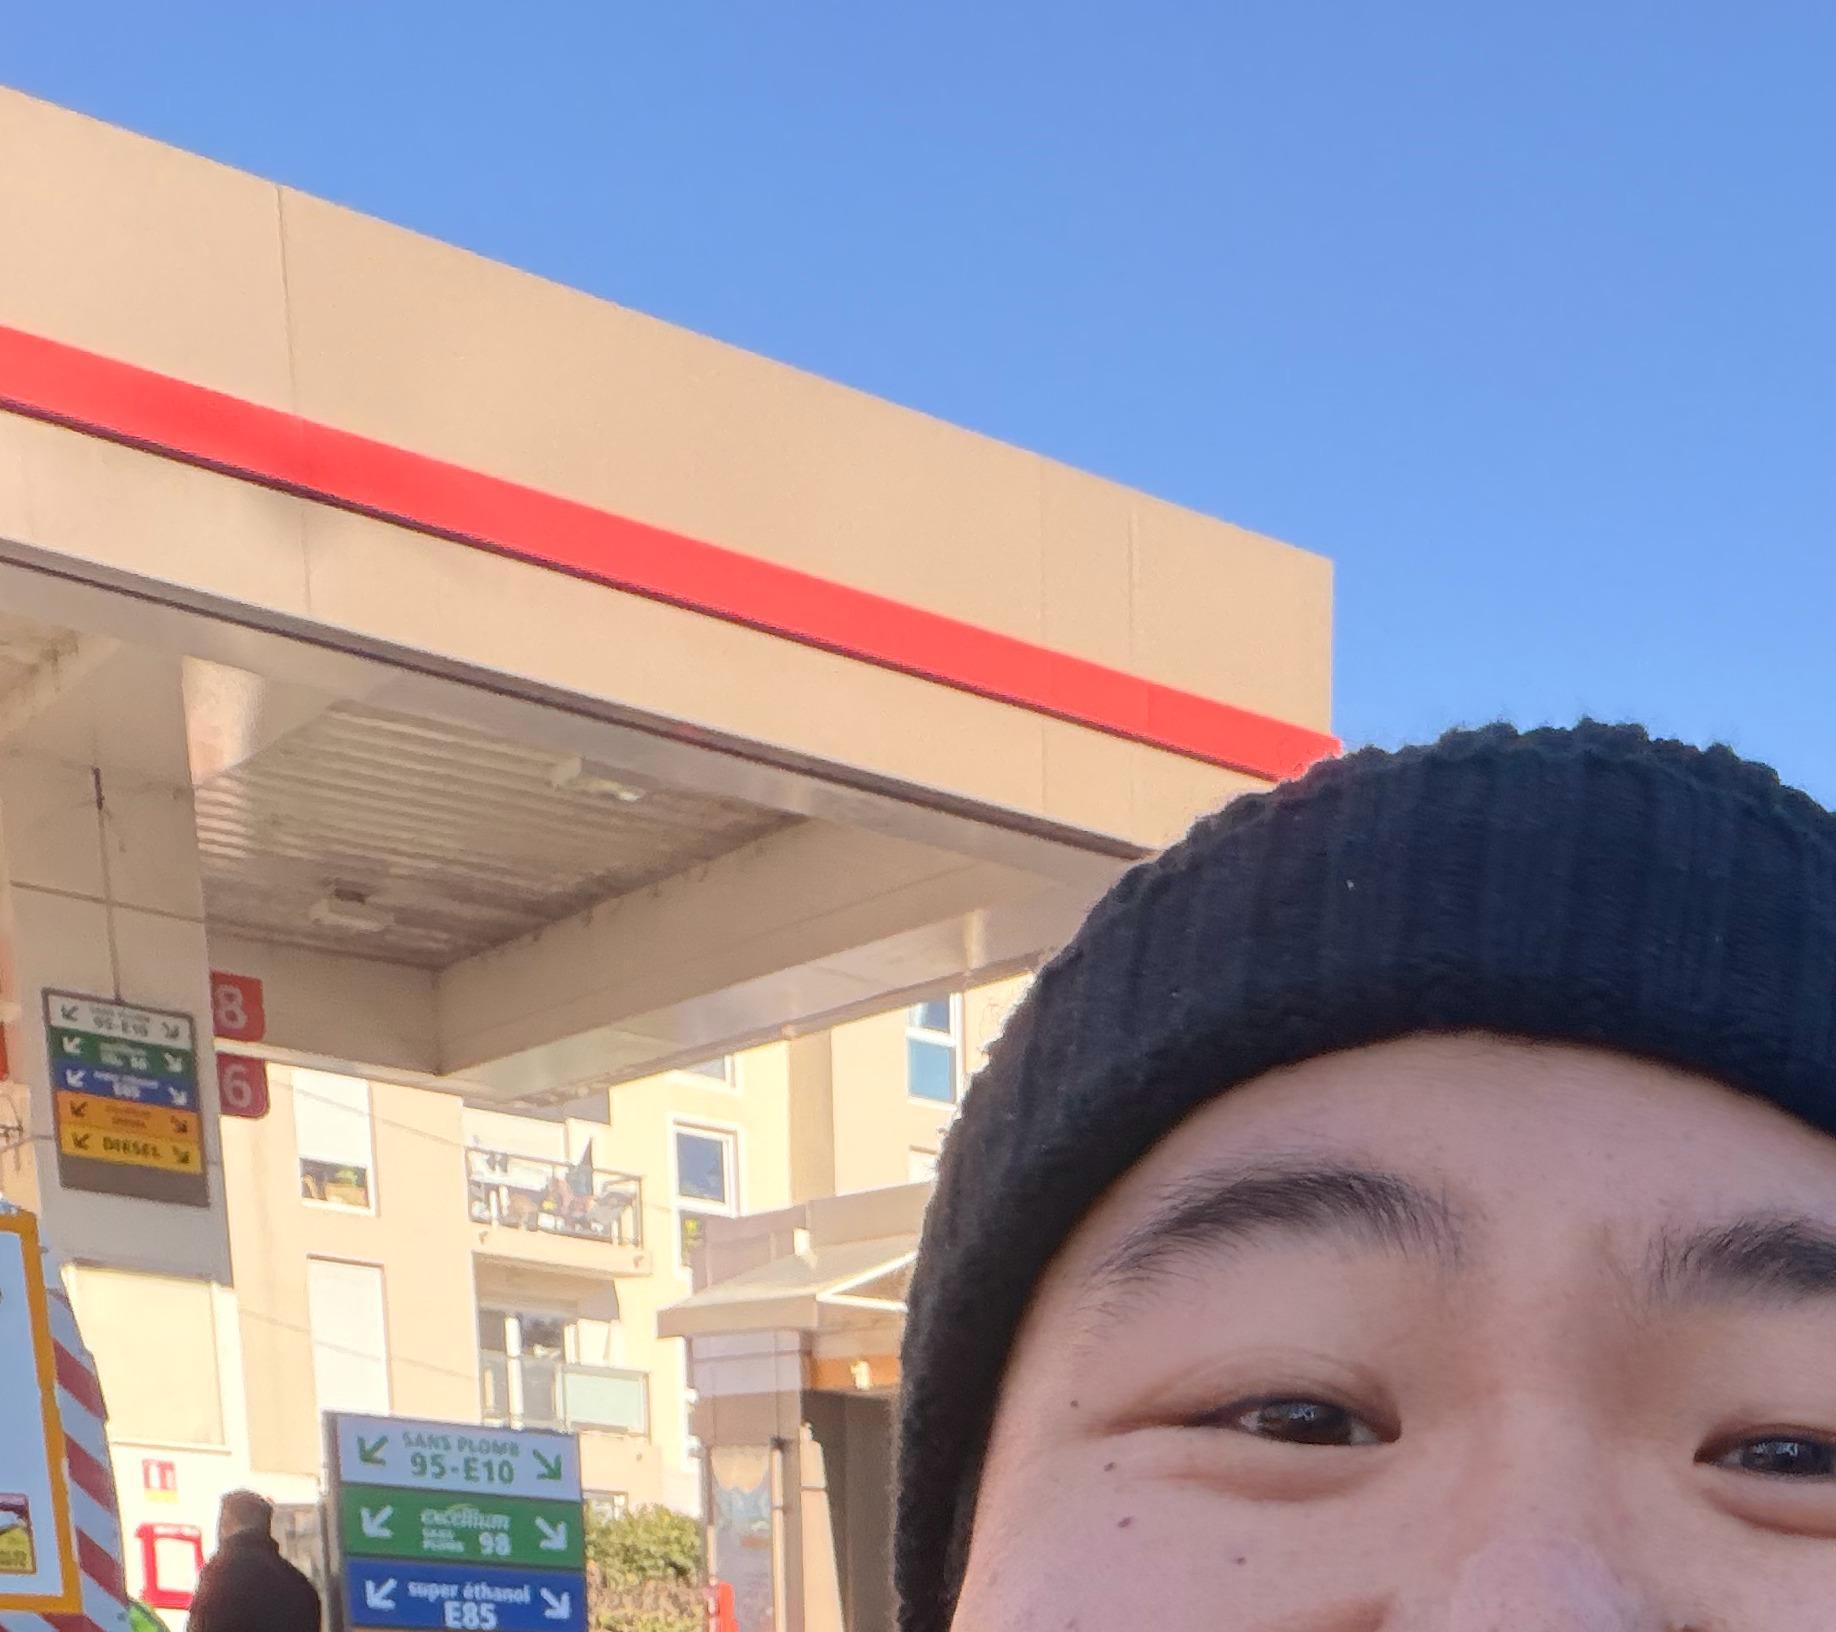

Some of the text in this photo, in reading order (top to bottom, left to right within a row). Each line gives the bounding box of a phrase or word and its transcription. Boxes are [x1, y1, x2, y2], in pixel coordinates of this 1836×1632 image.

[214, 984, 247, 1029] 8
[224, 1064, 252, 1107] 6
[103, 1136, 160, 1158] DIESEL
[403, 1431, 519, 1457] SANS PLOMB
[410, 1452, 515, 1484] 95-E10
[479, 1532, 512, 1556] 98
[407, 1581, 531, 1604] super éthanol
[444, 1601, 498, 1631] E85
